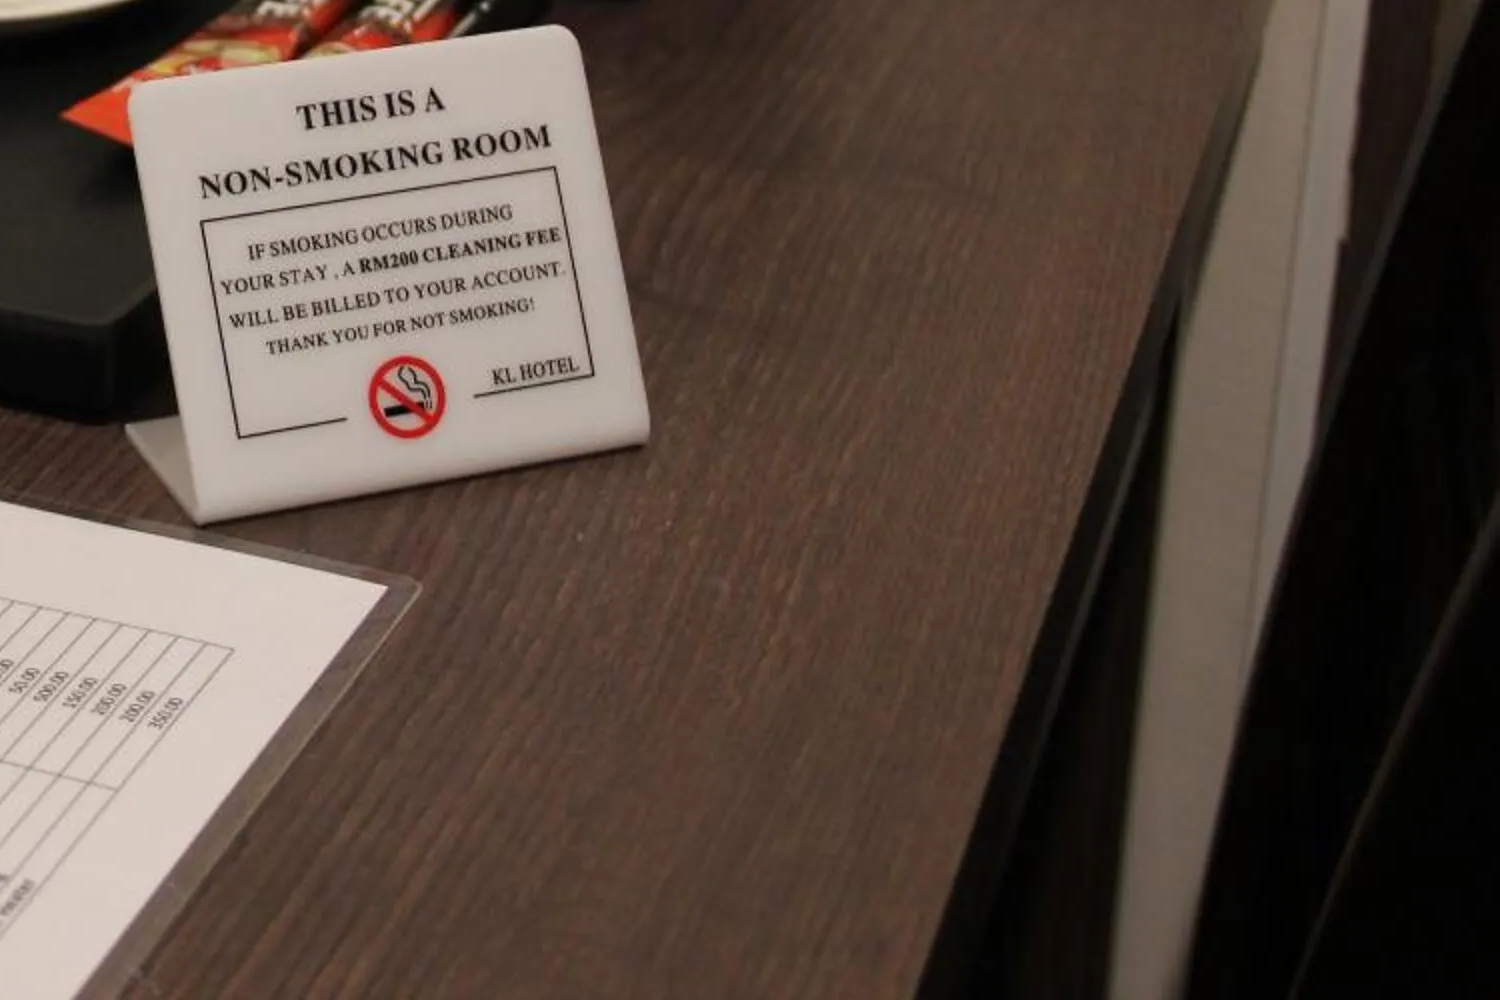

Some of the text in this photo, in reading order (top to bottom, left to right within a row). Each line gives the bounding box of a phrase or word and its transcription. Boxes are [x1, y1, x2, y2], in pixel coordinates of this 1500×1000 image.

[296, 86, 446, 132] THIS IS A
[198, 123, 552, 199] NON-SMOKING ROOM
[220, 266, 277, 296] YOUR
[279, 263, 329, 288] STAY
[342, 259, 356, 277] A
[359, 248, 420, 275] RM200
[423, 233, 523, 263] CLEANING
[525, 226, 562, 248] FEE
[247, 204, 514, 262] IF SMOKING OCCURS DURING
[229, 305, 279, 330] WILL
[282, 301, 309, 321] BE
[311, 292, 382, 317] BILLED
[385, 285, 409, 305] TO
[413, 277, 468, 302] YOUR
[266, 298, 536, 355] THANK YOU FOR NOT SMOKING!
[491, 356, 581, 388] KL HOTEL
